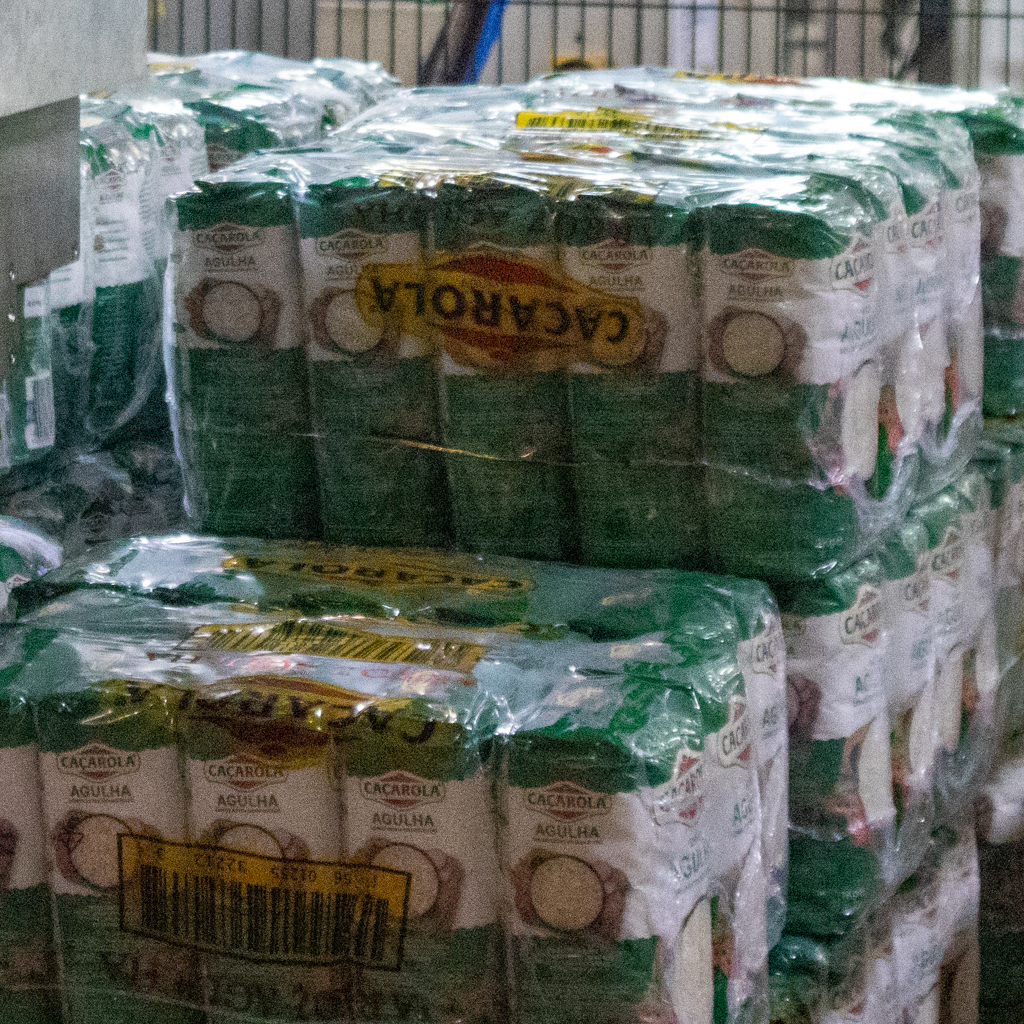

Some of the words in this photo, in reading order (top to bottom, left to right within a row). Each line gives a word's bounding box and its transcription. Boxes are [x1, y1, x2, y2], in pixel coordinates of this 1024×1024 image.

[204, 255, 256, 267] AGULHA
[70, 784, 132, 798] AGULHA
[216, 793, 280, 808] AGULHA
[371, 812, 435, 827] AGULHA
[535, 822, 600, 839] AGULHA
